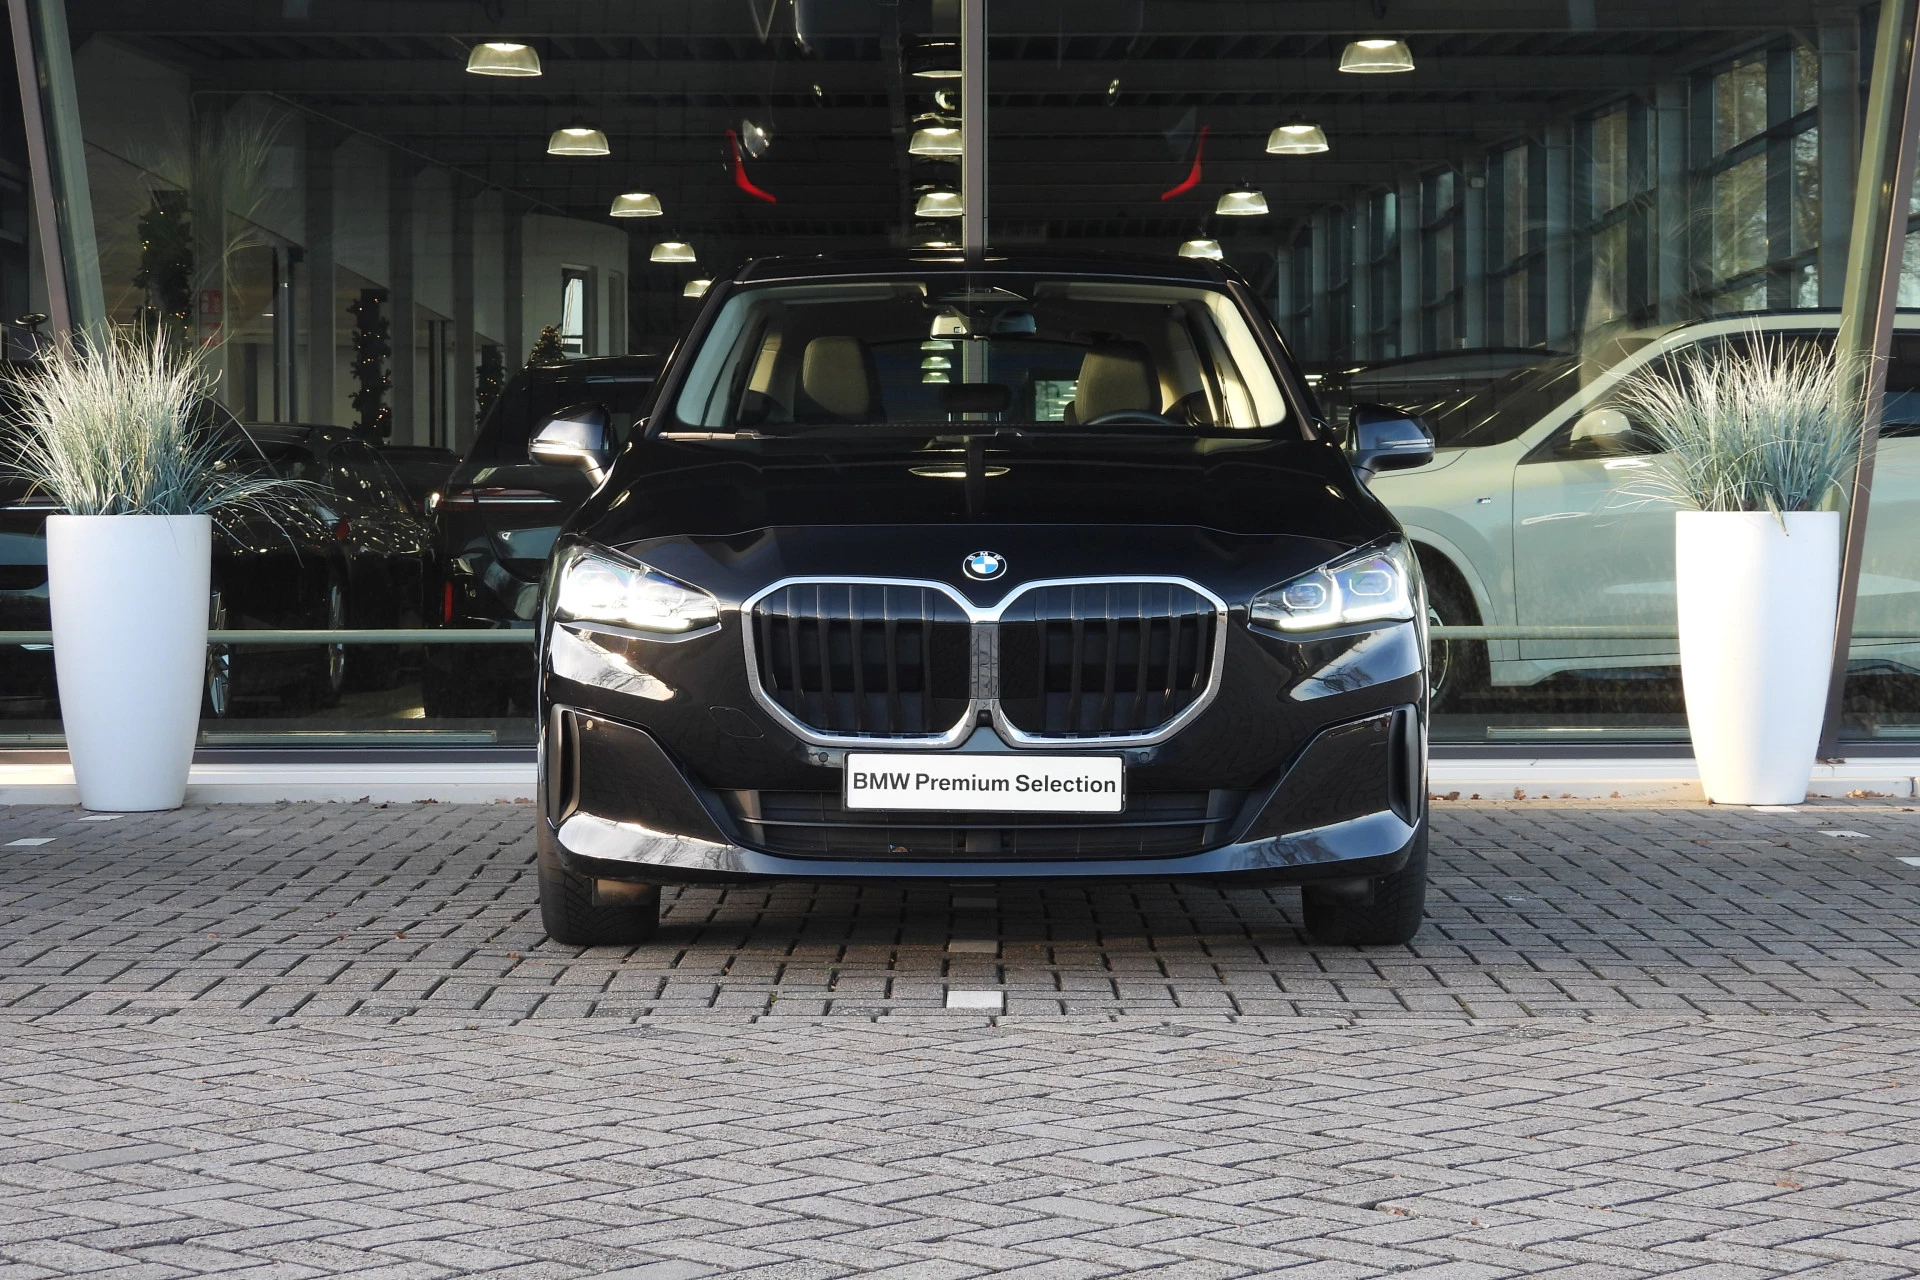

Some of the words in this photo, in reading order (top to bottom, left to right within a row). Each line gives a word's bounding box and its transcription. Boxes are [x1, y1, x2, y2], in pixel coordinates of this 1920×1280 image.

[967, 551, 1003, 560] BMW
[853, 772, 911, 790] BMW
[915, 773, 1010, 792] Premium
[1015, 774, 1116, 793] Selection
